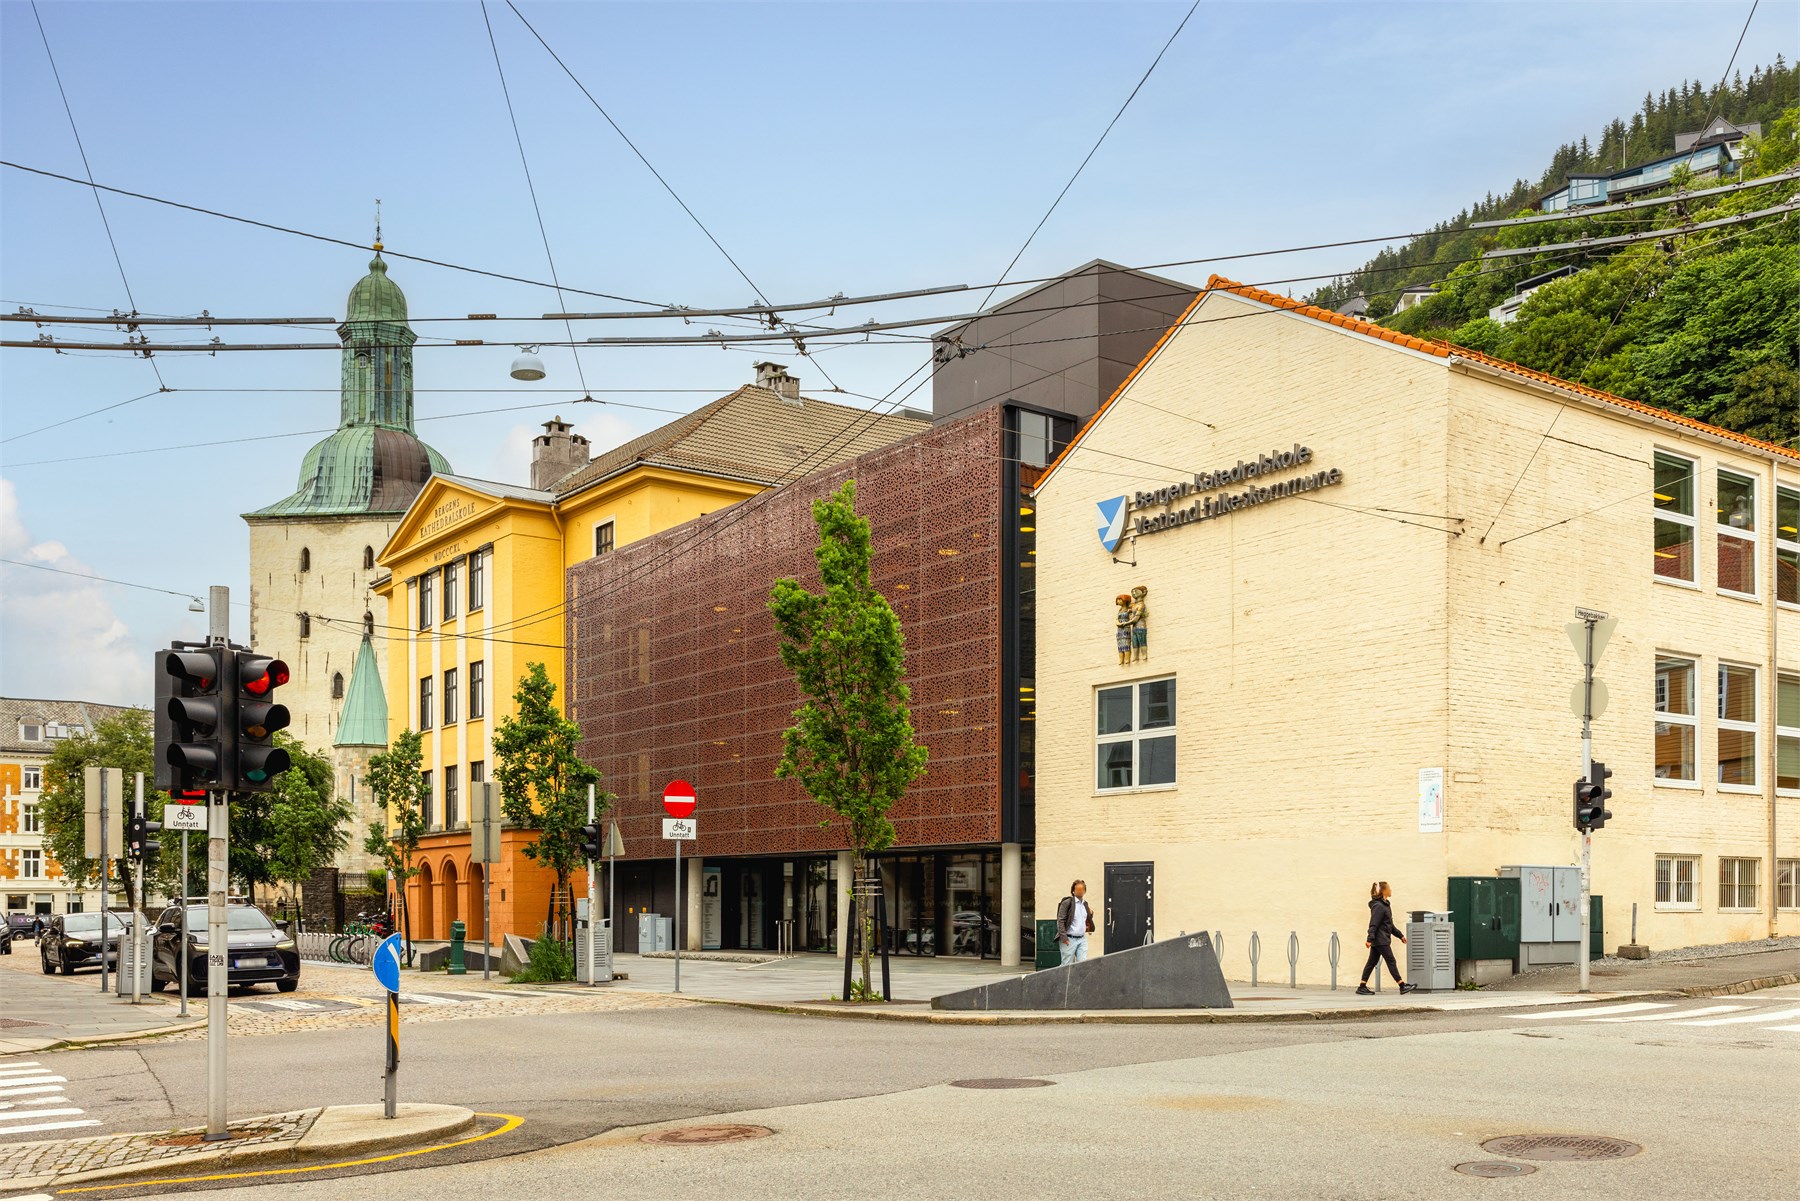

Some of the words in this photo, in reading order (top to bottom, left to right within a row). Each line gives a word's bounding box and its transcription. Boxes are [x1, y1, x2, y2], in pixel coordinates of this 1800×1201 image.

[1135, 480, 1190, 509] Bergen
[1194, 443, 1313, 491] Katedralskole
[434, 498, 460, 518] BERGENS
[1134, 499, 1201, 533] Vestland
[1203, 466, 1342, 520] fylkeskommune
[420, 502, 475, 538] KATHEDRALSKOLE
[433, 543, 461, 562] MDCCCXL
